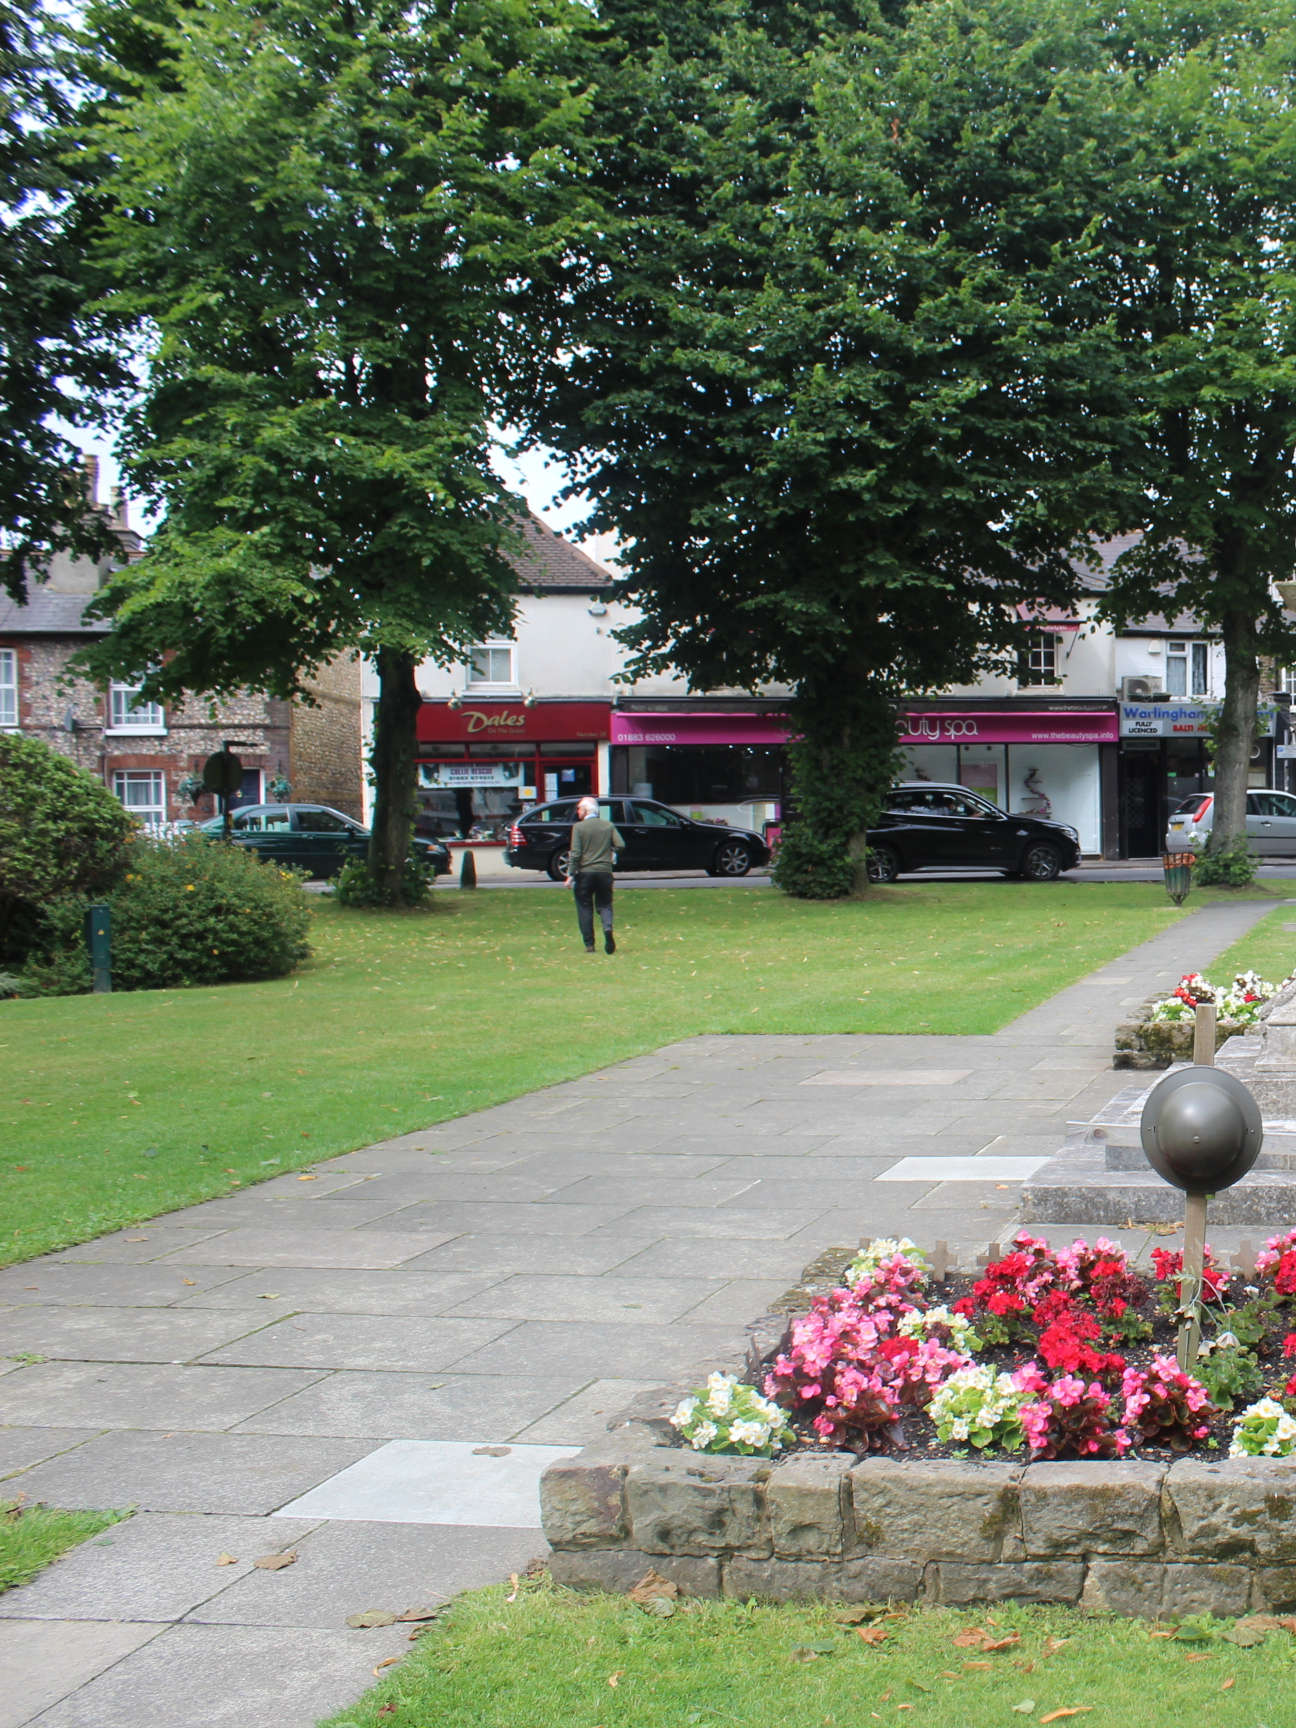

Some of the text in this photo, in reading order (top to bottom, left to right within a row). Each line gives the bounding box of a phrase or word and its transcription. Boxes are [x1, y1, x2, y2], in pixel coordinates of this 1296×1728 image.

[1123, 707, 1210, 721] Warlingham
[460, 710, 525, 733] Dales
[1134, 721, 1153, 729] FULLY
[944, 720, 978, 740] spa
[1172, 724, 1194, 732] BALTI
[617, 733, 676, 742] 01883 626000
[1031, 731, 1114, 741] www.thebeautyspa.info
